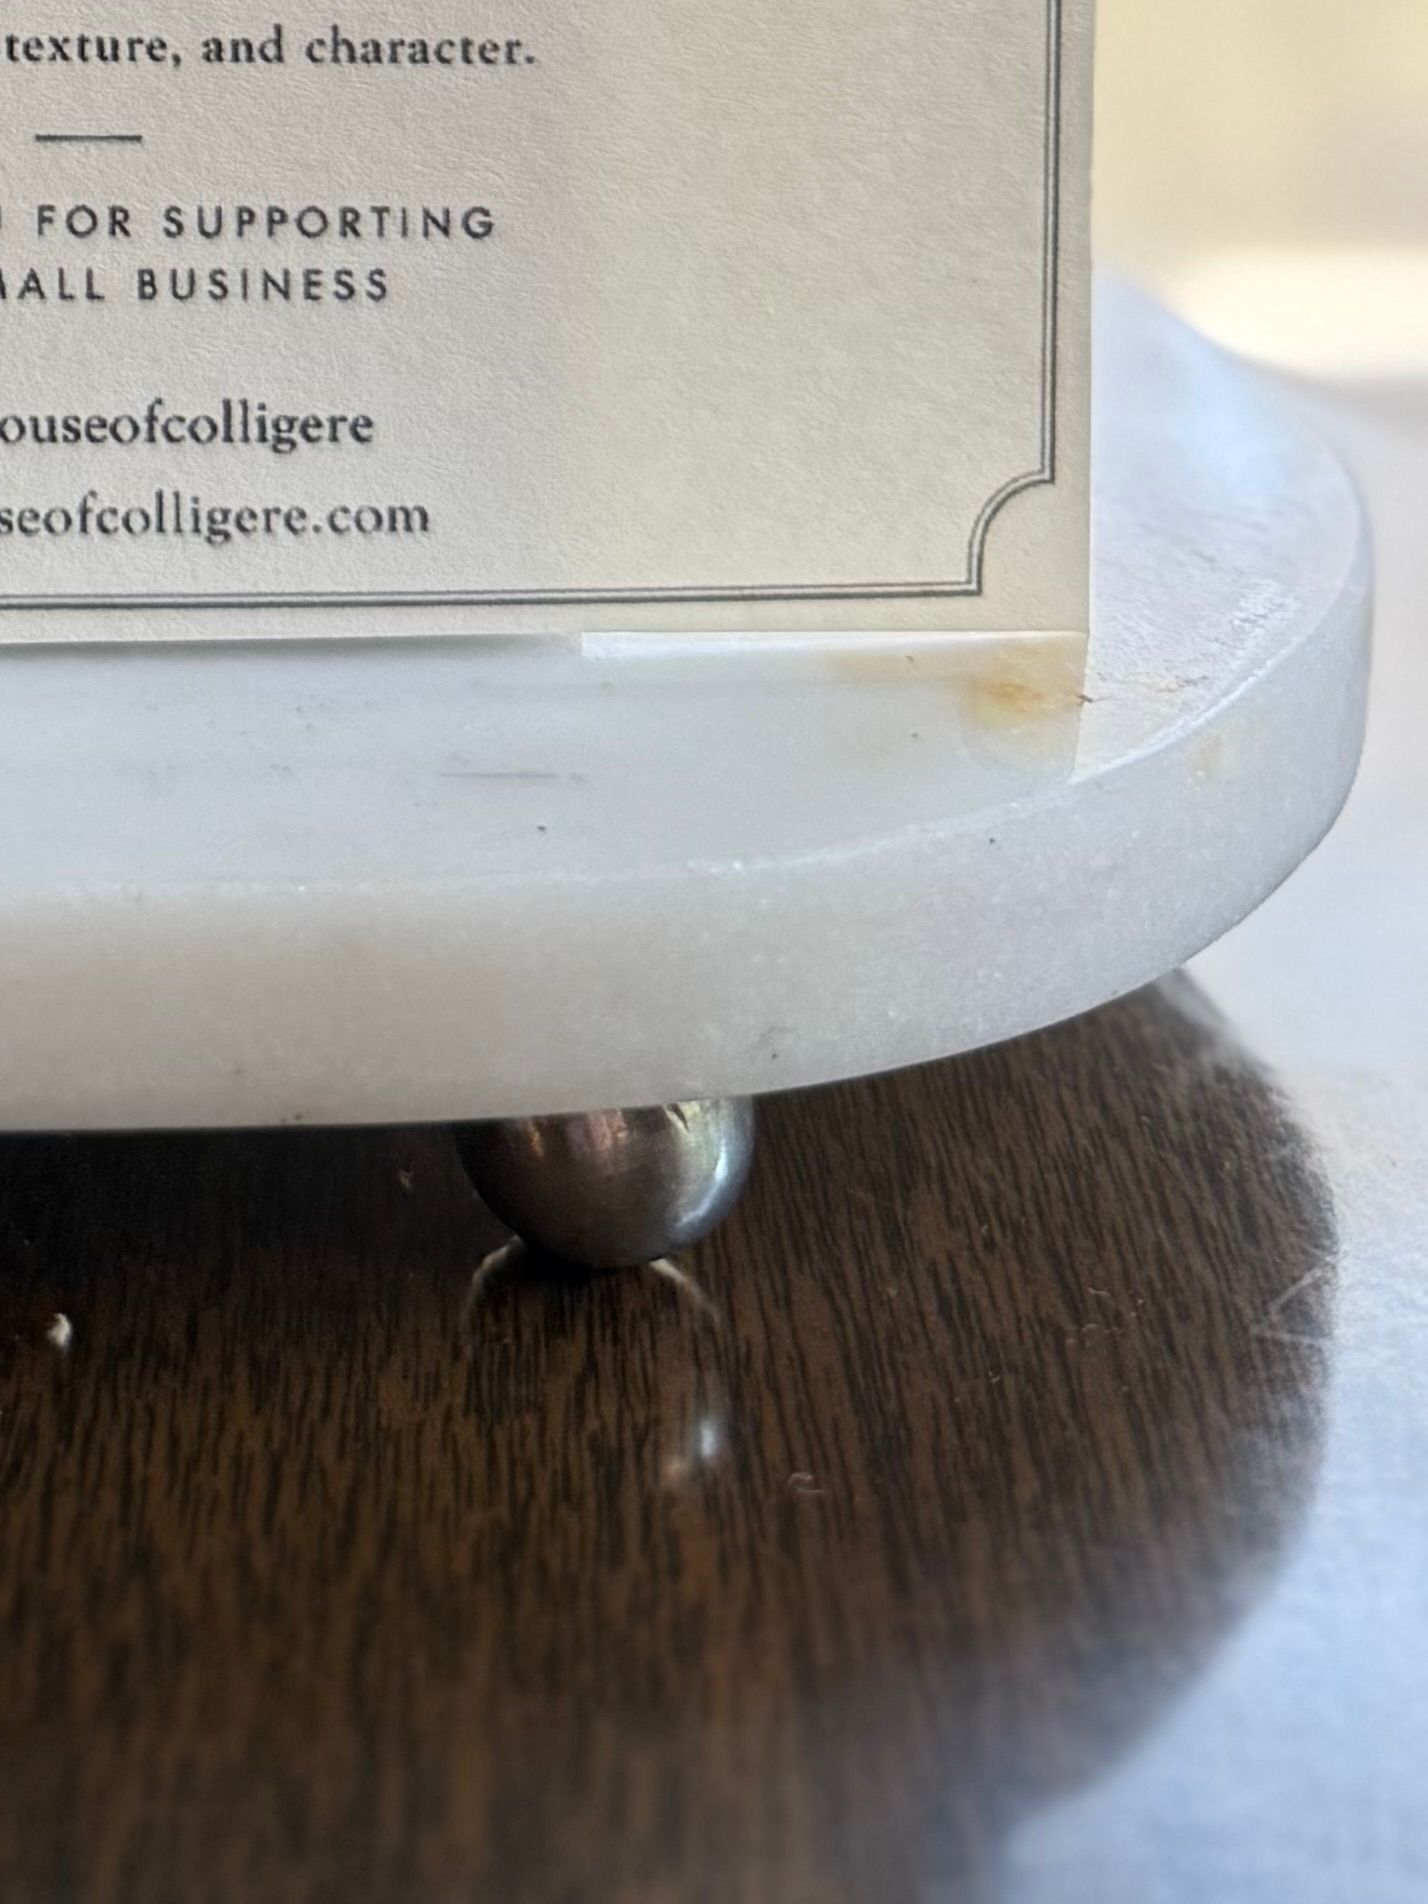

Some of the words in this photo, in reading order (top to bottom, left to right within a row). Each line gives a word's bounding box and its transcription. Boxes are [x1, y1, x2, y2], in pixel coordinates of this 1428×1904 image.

[6, 34, 181, 68] texture,
[202, 24, 284, 64] and
[305, 24, 535, 65] character.
[38, 205, 131, 239] FOR
[163, 206, 494, 241] SUPPORTING
[138, 268, 387, 303] BUSINESS
